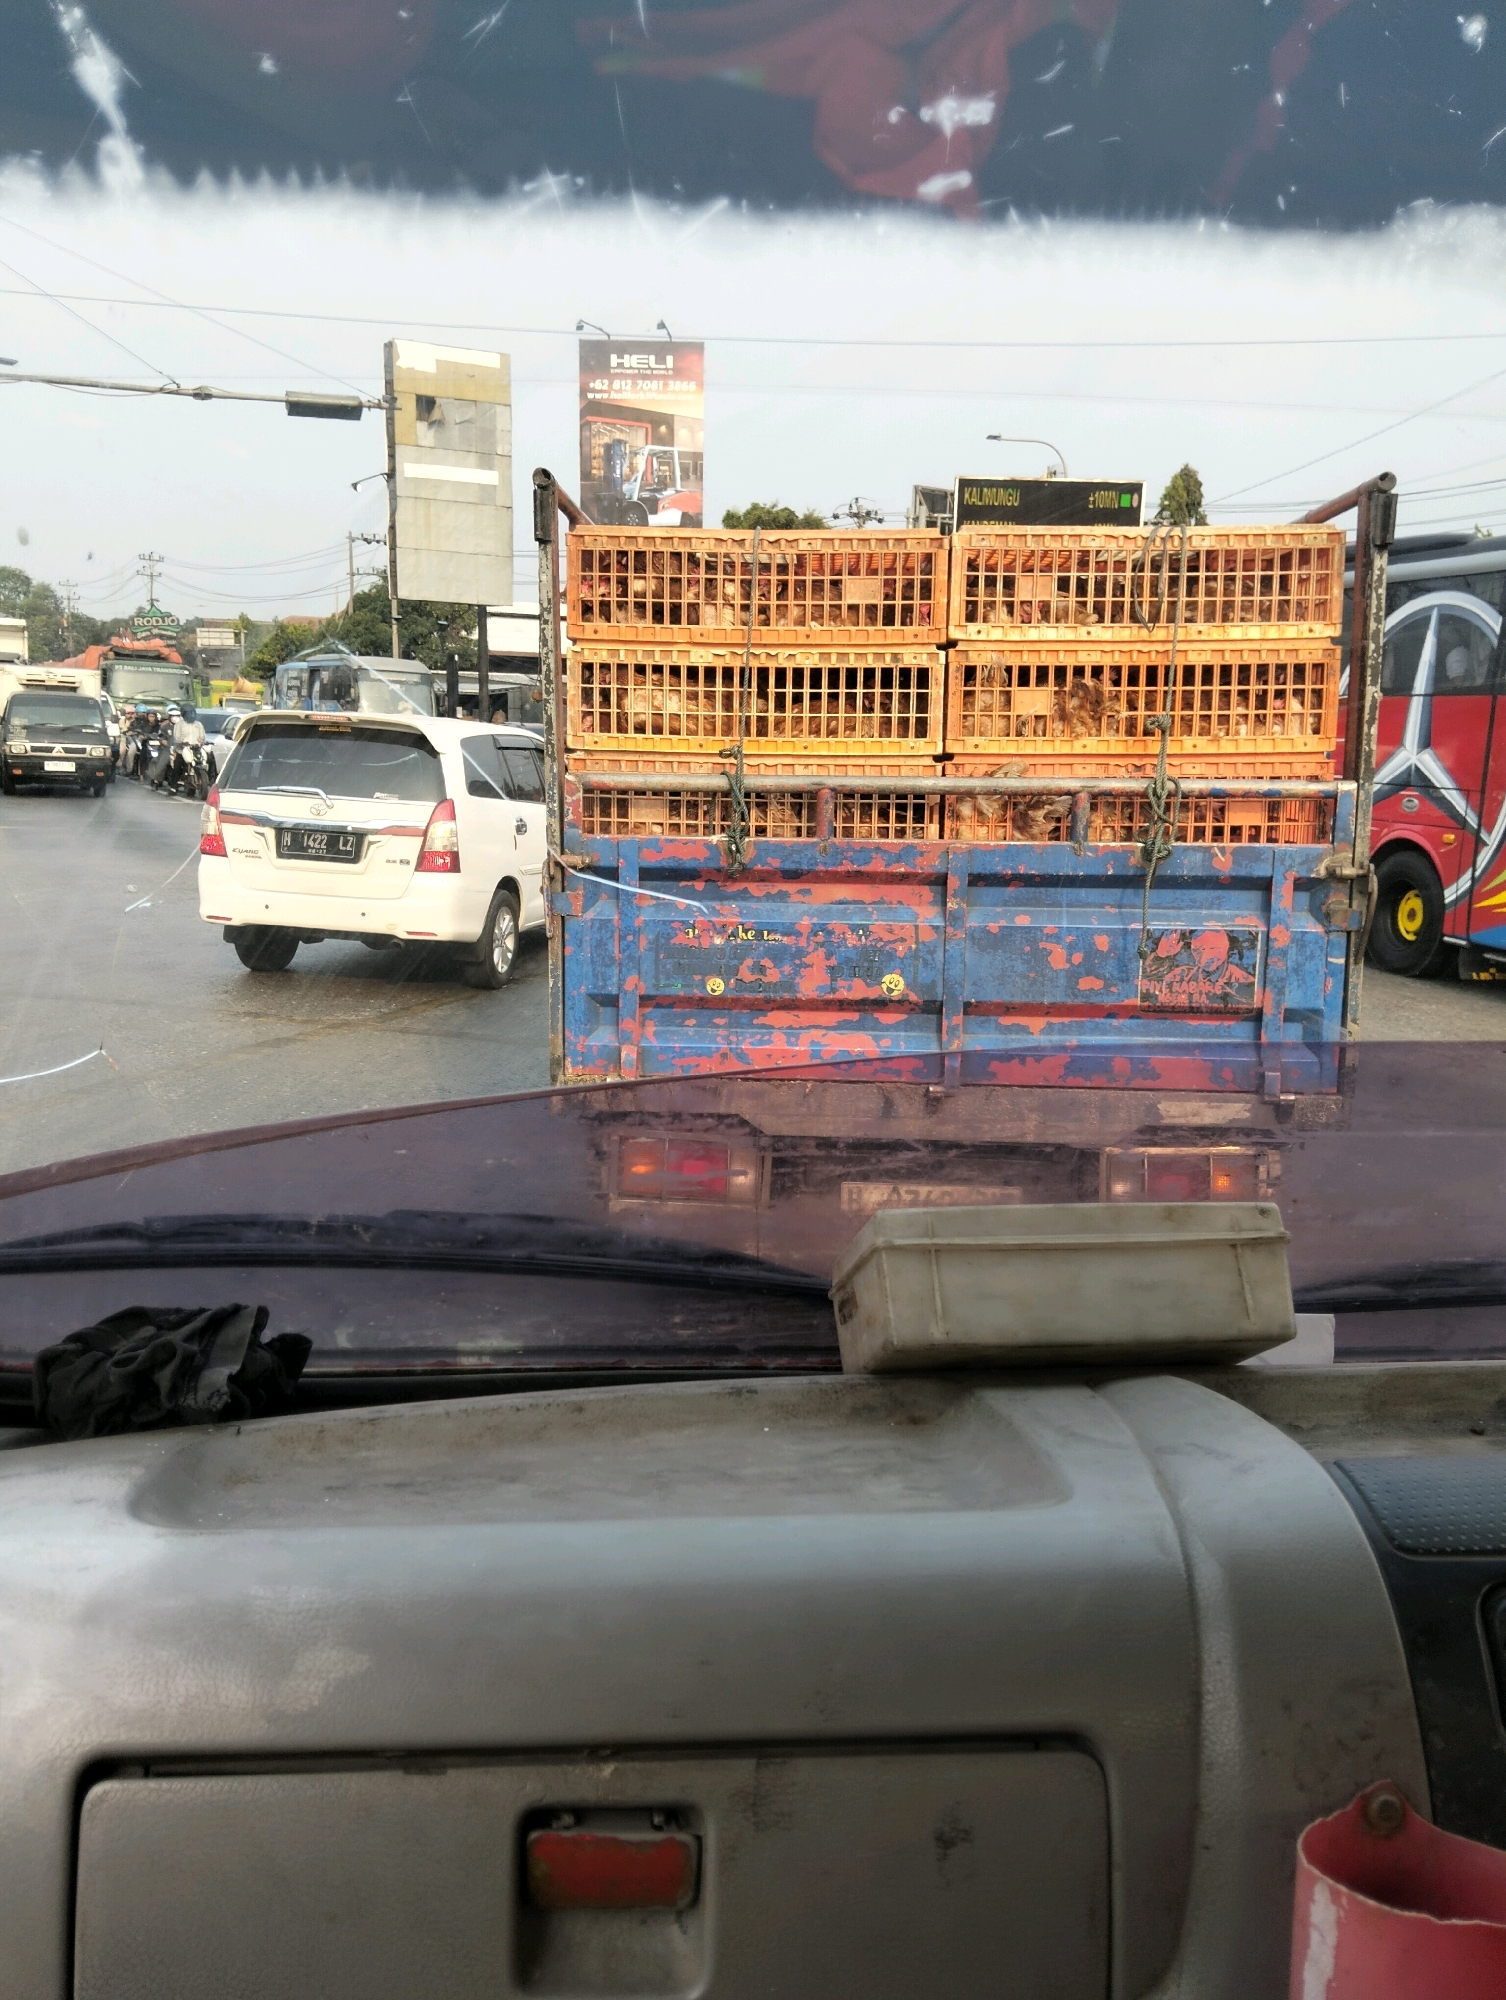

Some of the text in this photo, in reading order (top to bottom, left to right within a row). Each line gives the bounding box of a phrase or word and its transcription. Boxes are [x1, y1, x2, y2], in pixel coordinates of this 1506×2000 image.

[610, 354, 674, 368] HELI
[589, 379, 609, 390] +62
[133, 616, 178, 626] RODJO
[283, 831, 354, 851] H 1422 LZ
